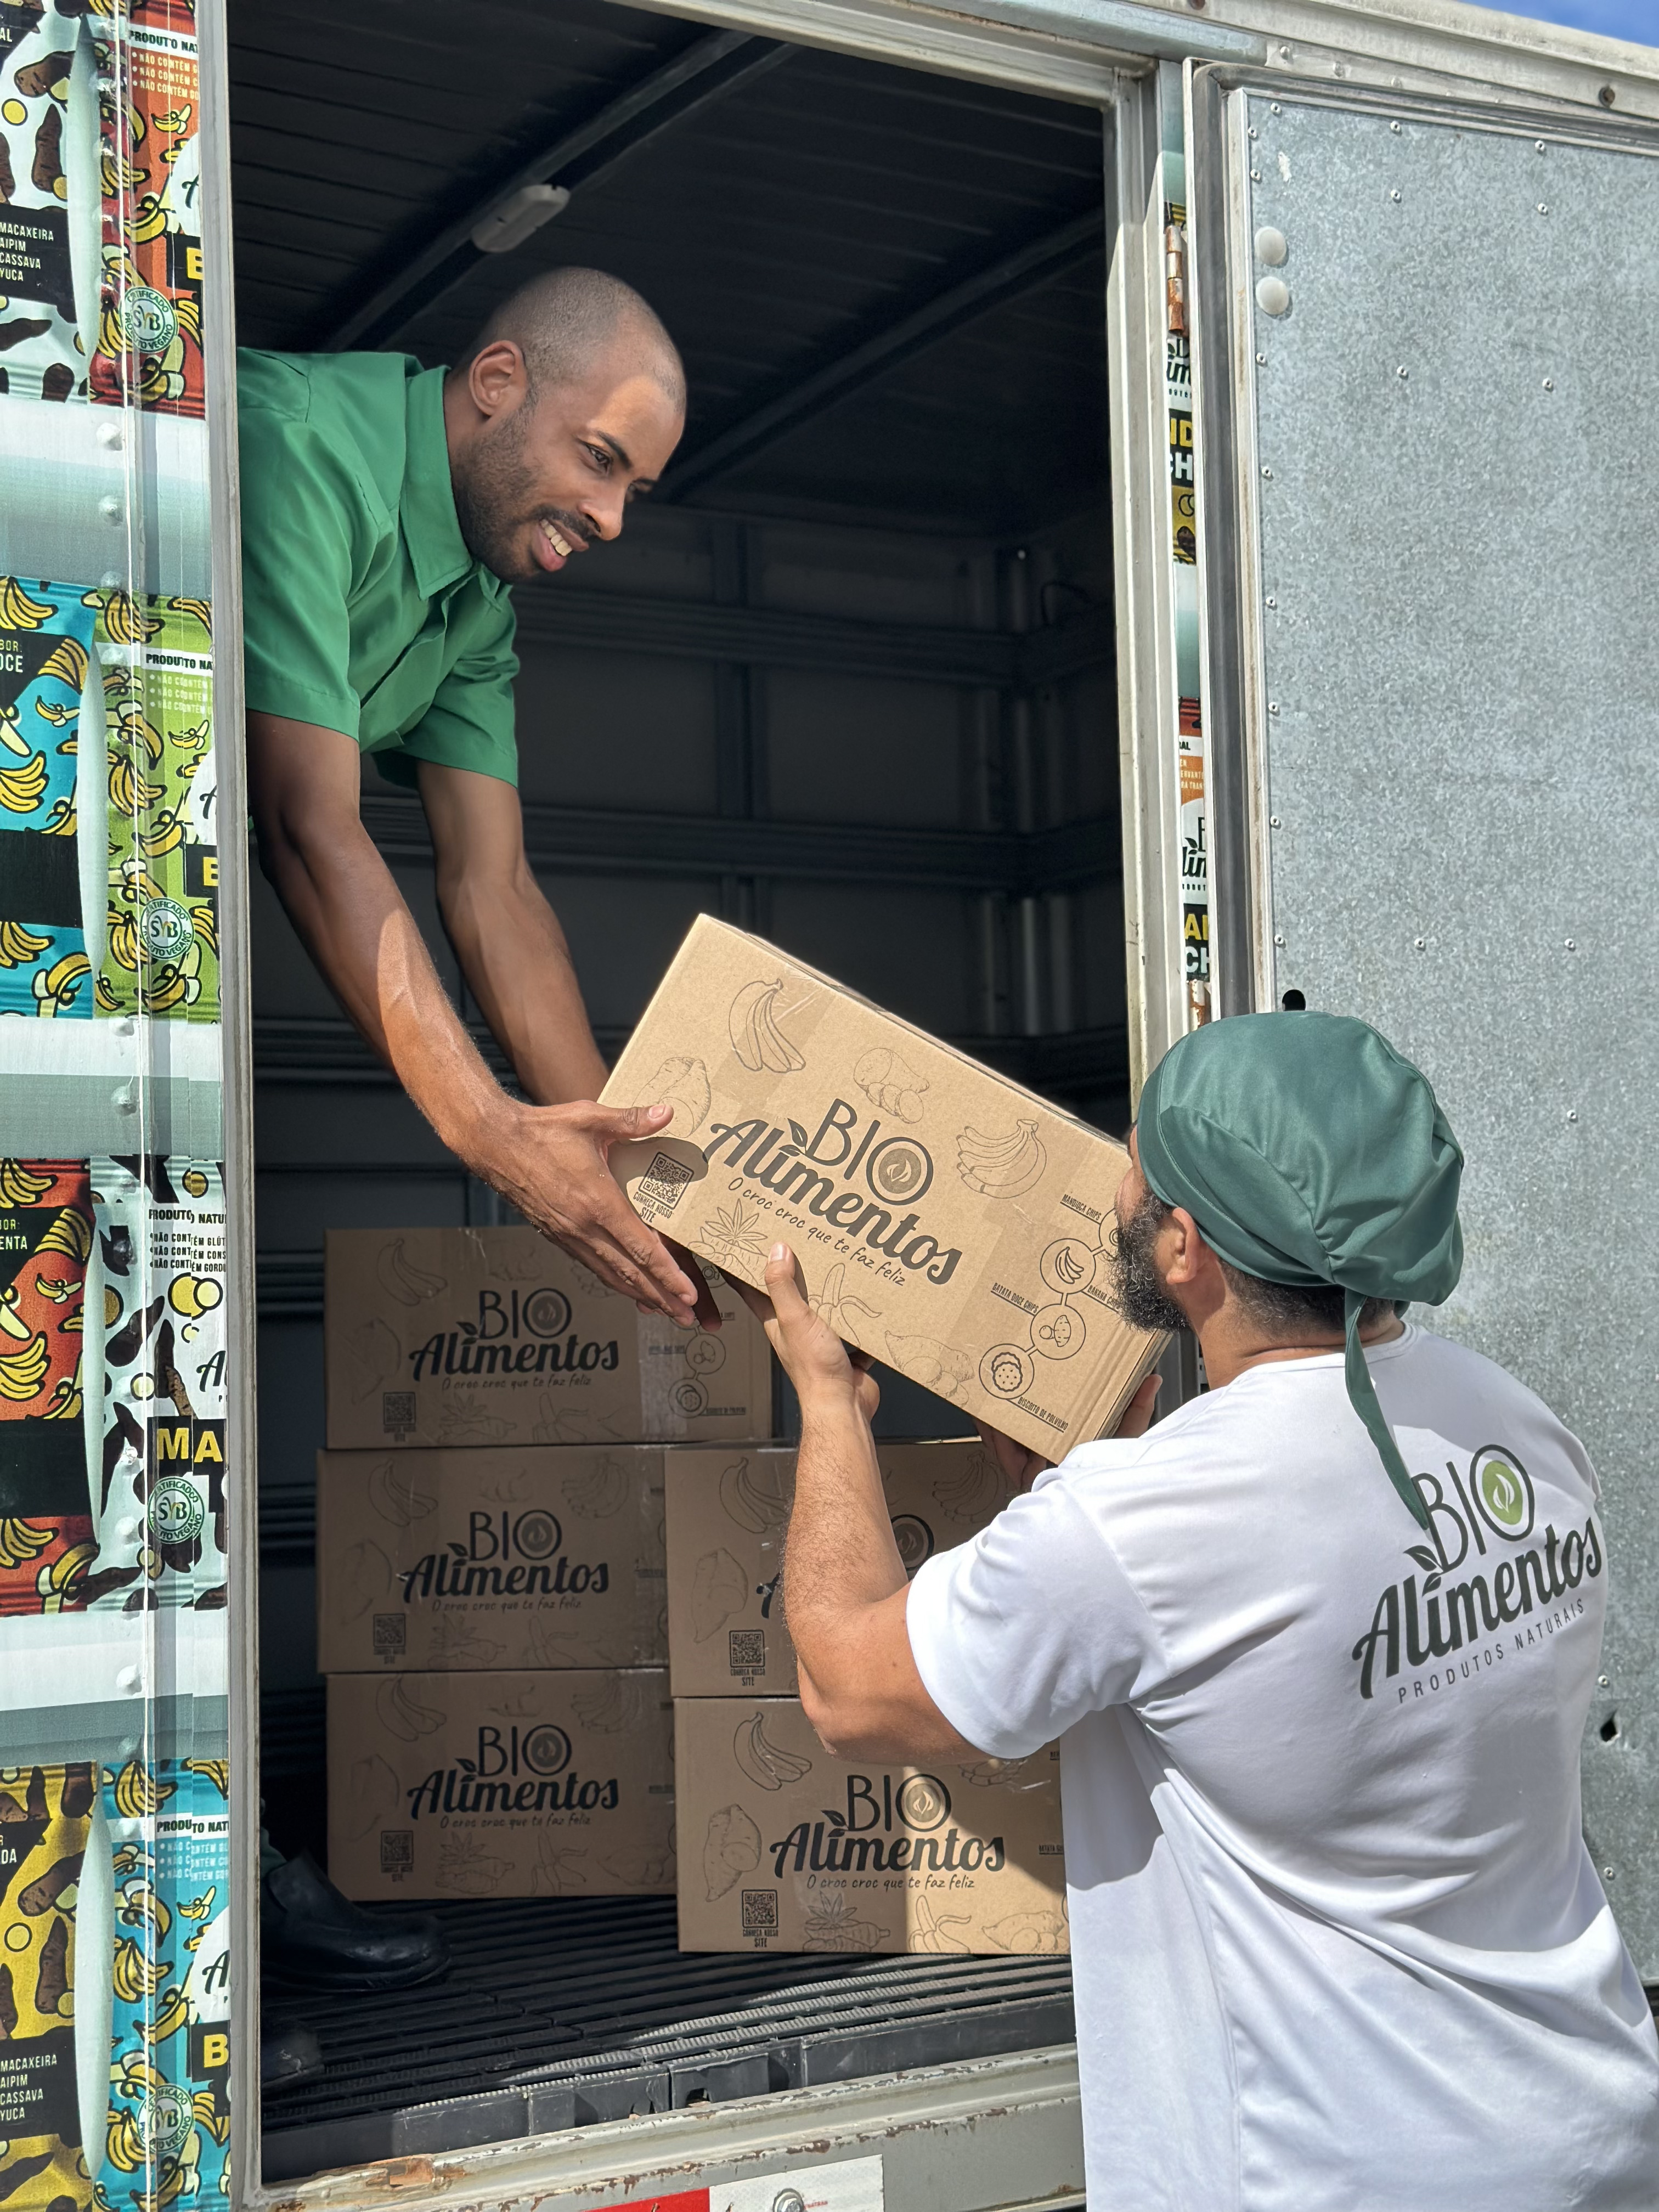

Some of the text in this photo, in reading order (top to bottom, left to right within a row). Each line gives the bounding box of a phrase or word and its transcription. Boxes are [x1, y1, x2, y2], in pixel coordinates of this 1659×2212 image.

[0, 222, 54, 241] MACAXEIRA
[0, 237, 26, 252] AIPIM
[0, 251, 41, 269] CASSAVA
[0, 267, 24, 281] YUCA
[805, 1098, 934, 1206] BIO
[655, 1204, 673, 1220] NOSSO
[703, 1119, 963, 1286] Alimentos
[198, 1213, 227, 1224] NATU
[639, 1206, 656, 1223] SITE
[1086, 1207, 1102, 1222] CHIPS
[153, 1232, 168, 1243] NÃO
[171, 1233, 205, 1246] CONTÉM
[728, 1177, 906, 1286] O croc croc que te faz feliz
[153, 1245, 168, 1256] NÃO
[171, 1246, 205, 1260] CONTÉM
[154, 1258, 168, 1269] NÃO
[992, 1282, 1040, 1314] BATATA DOCE CHIPS
[478, 1287, 572, 1340] BIO
[408, 1332, 620, 1382] Alimentos
[511, 1379, 529, 1392] que
[569, 1373, 592, 1388] feliz
[157, 1427, 223, 1463] MA
[1411, 1444, 1536, 1573] BIO
[469, 1509, 563, 1561] BIO
[396, 1553, 610, 1604] Alimentos
[1351, 1516, 1602, 1700] Alimentos
[1397, 1598, 1585, 1703] PRODUTOS NATURAIS
[478, 1724, 573, 1776] BIO
[407, 1769, 619, 1820] Alimentos
[846, 1773, 952, 1833] BIO
[156, 1819, 229, 1834] PRODUTO NAT
[769, 1822, 1005, 1879] Alimentos
[806, 1874, 975, 1892] O croc croc que te faz feliz
[0, 2054, 58, 2072] MACAXEIRA
[0, 2074, 28, 2089] AIPIM
[0, 2088, 43, 2106] CASSAVA
[0, 2107, 25, 2121] YUCA
